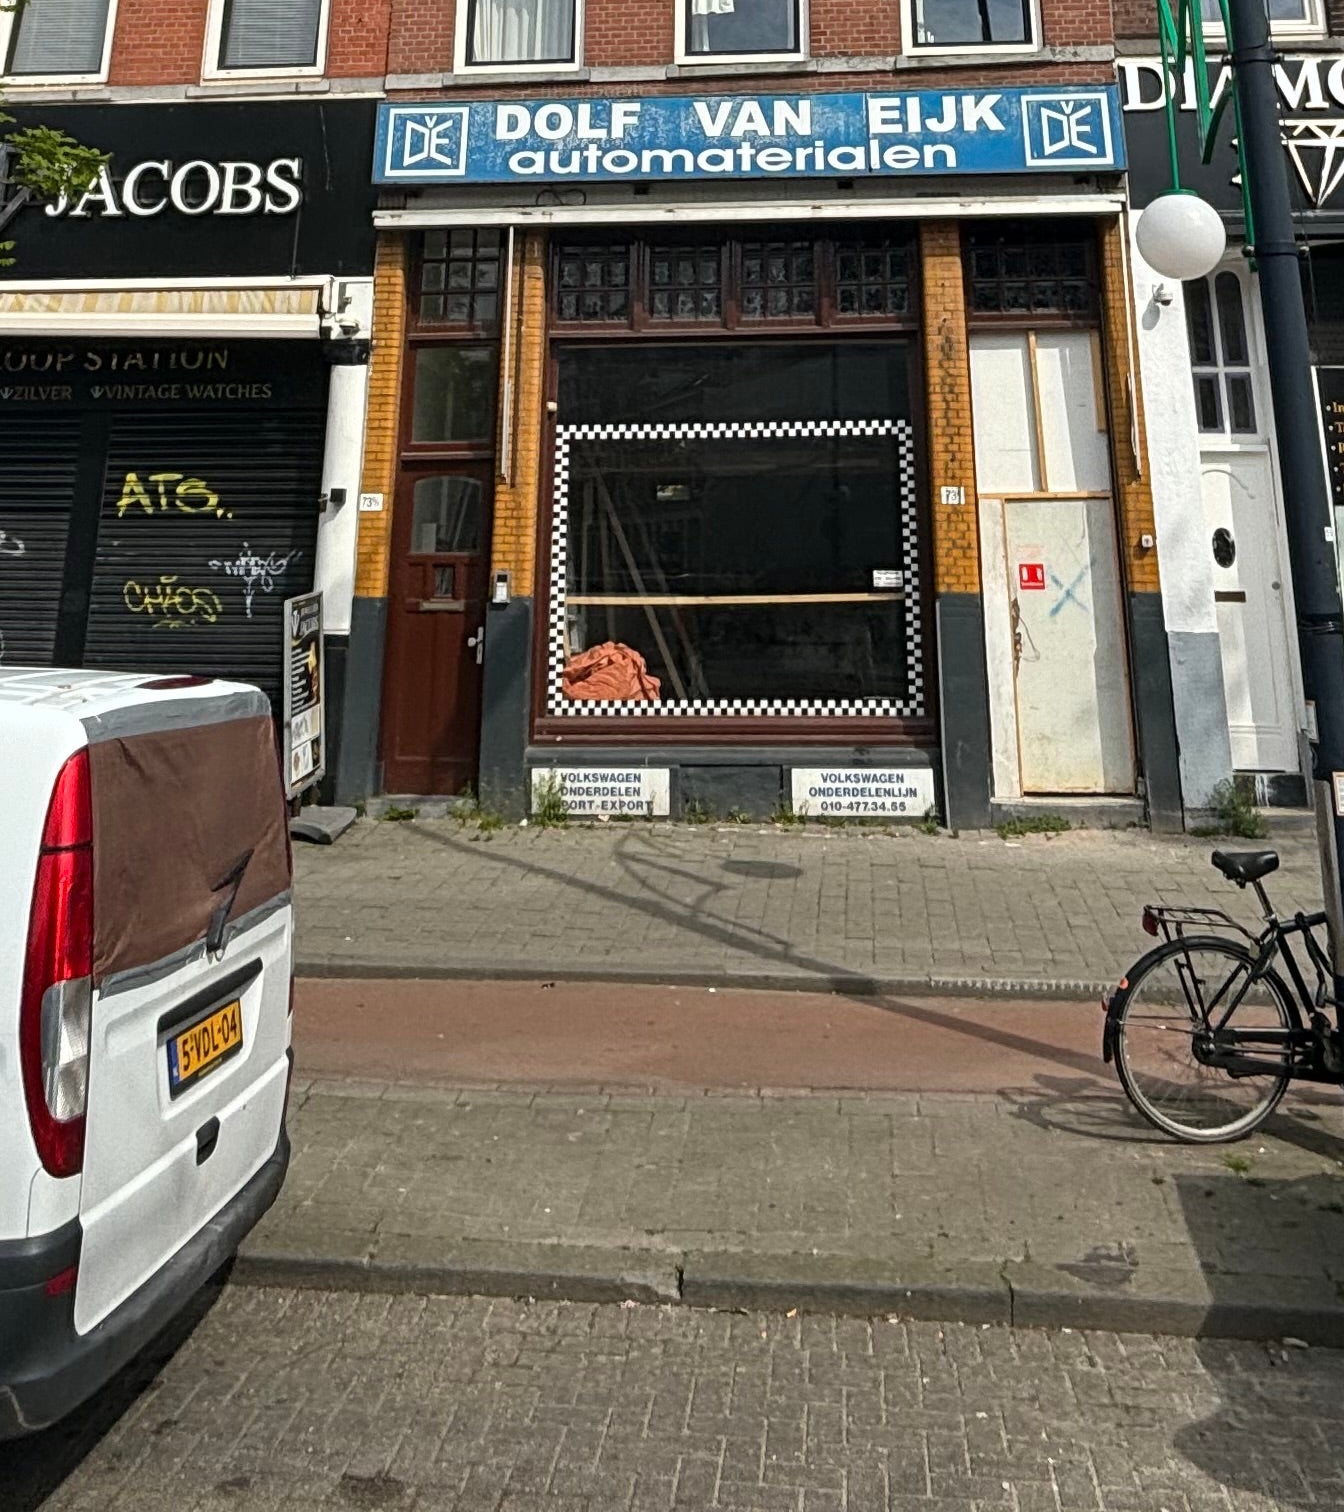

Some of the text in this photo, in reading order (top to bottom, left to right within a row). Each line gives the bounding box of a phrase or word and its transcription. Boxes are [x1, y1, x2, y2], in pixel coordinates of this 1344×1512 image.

[495, 94, 1005, 140] DOLF VAN EIJK
[508, 139, 956, 174] automaterialen
[44, 157, 304, 217] JACOBS
[13, 386, 72, 400] ZILVER
[106, 385, 181, 399] VINTAGE
[186, 383, 272, 399] WATCHES
[560, 772, 641, 783] VOLKSWAGEN
[821, 772, 904, 784] VOLKSWAGEN
[560, 786, 641, 797] ONDERDELEN
[808, 787, 917, 798] ONDERDELENLIJN
[182, 1007, 237, 1071] 5-VDL-04
